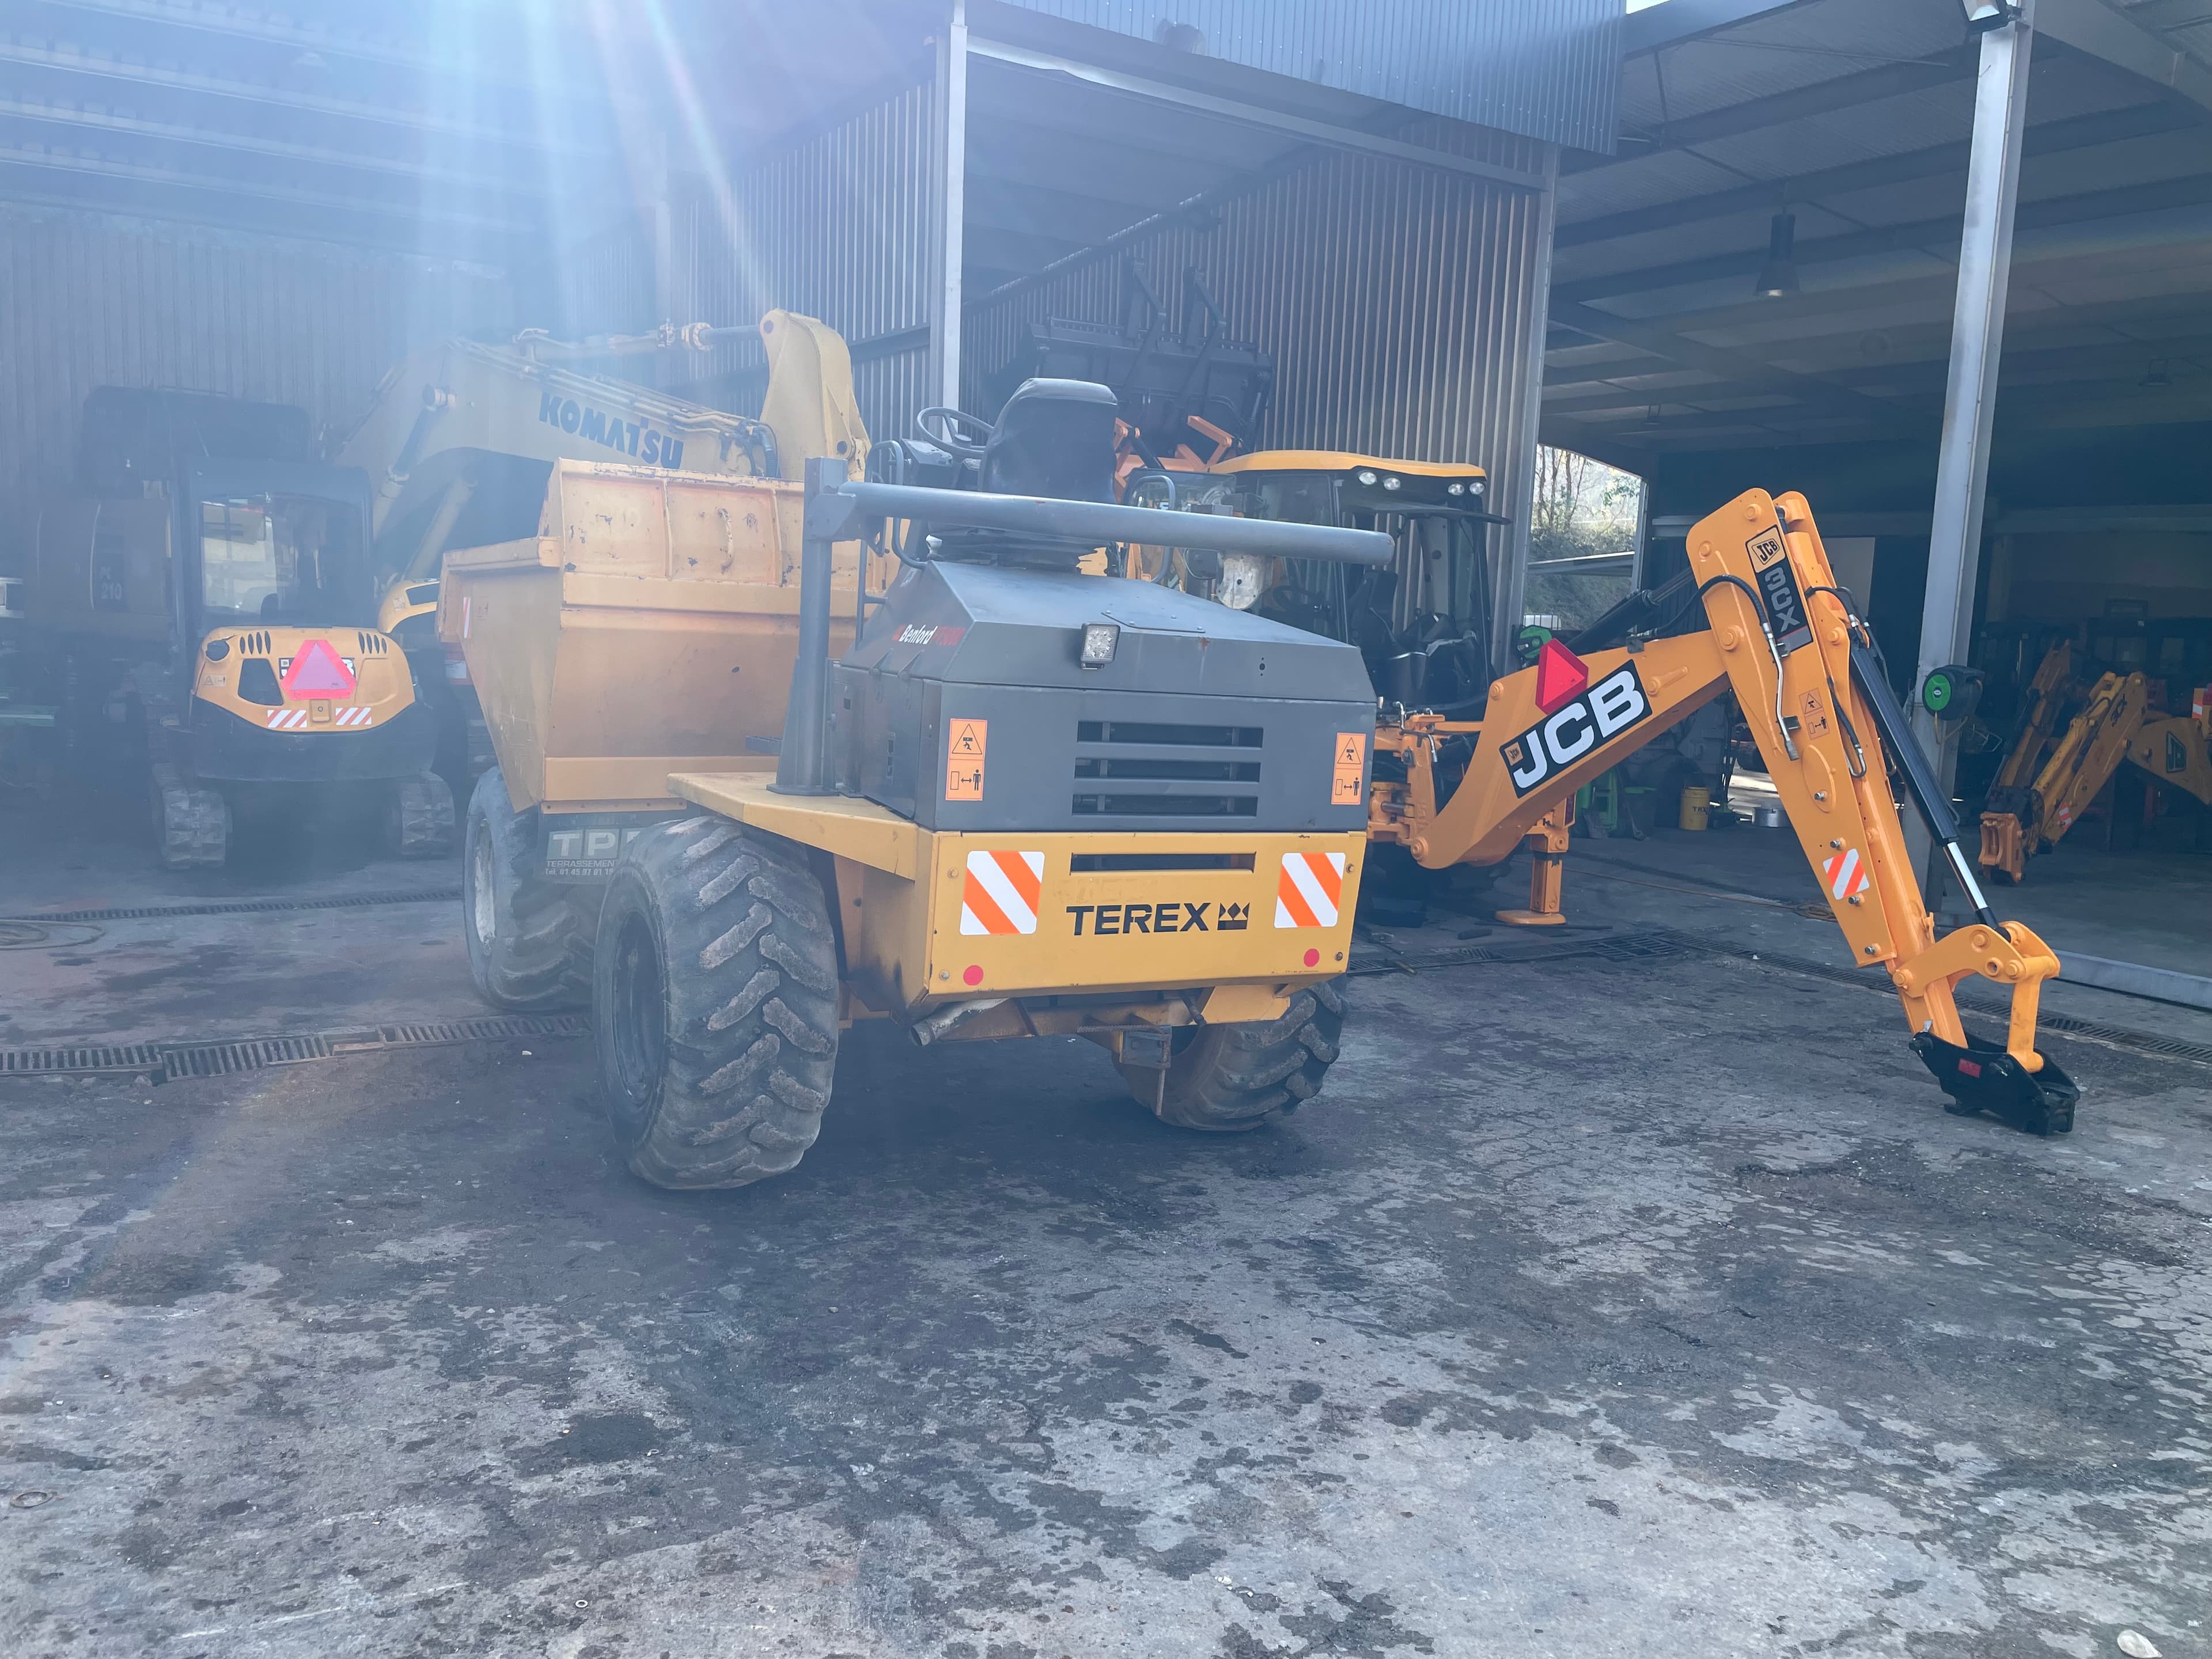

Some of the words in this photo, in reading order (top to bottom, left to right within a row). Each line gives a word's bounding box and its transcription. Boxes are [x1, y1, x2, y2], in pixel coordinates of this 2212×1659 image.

[539, 391, 684, 469] KOMATSU
[1756, 540, 1778, 562] JCB
[101, 583, 122, 600] 210
[1764, 567, 1800, 632] 3CX
[899, 624, 938, 645] Benford
[1513, 671, 1644, 789] JCB
[1066, 903, 1211, 935] TEREX
